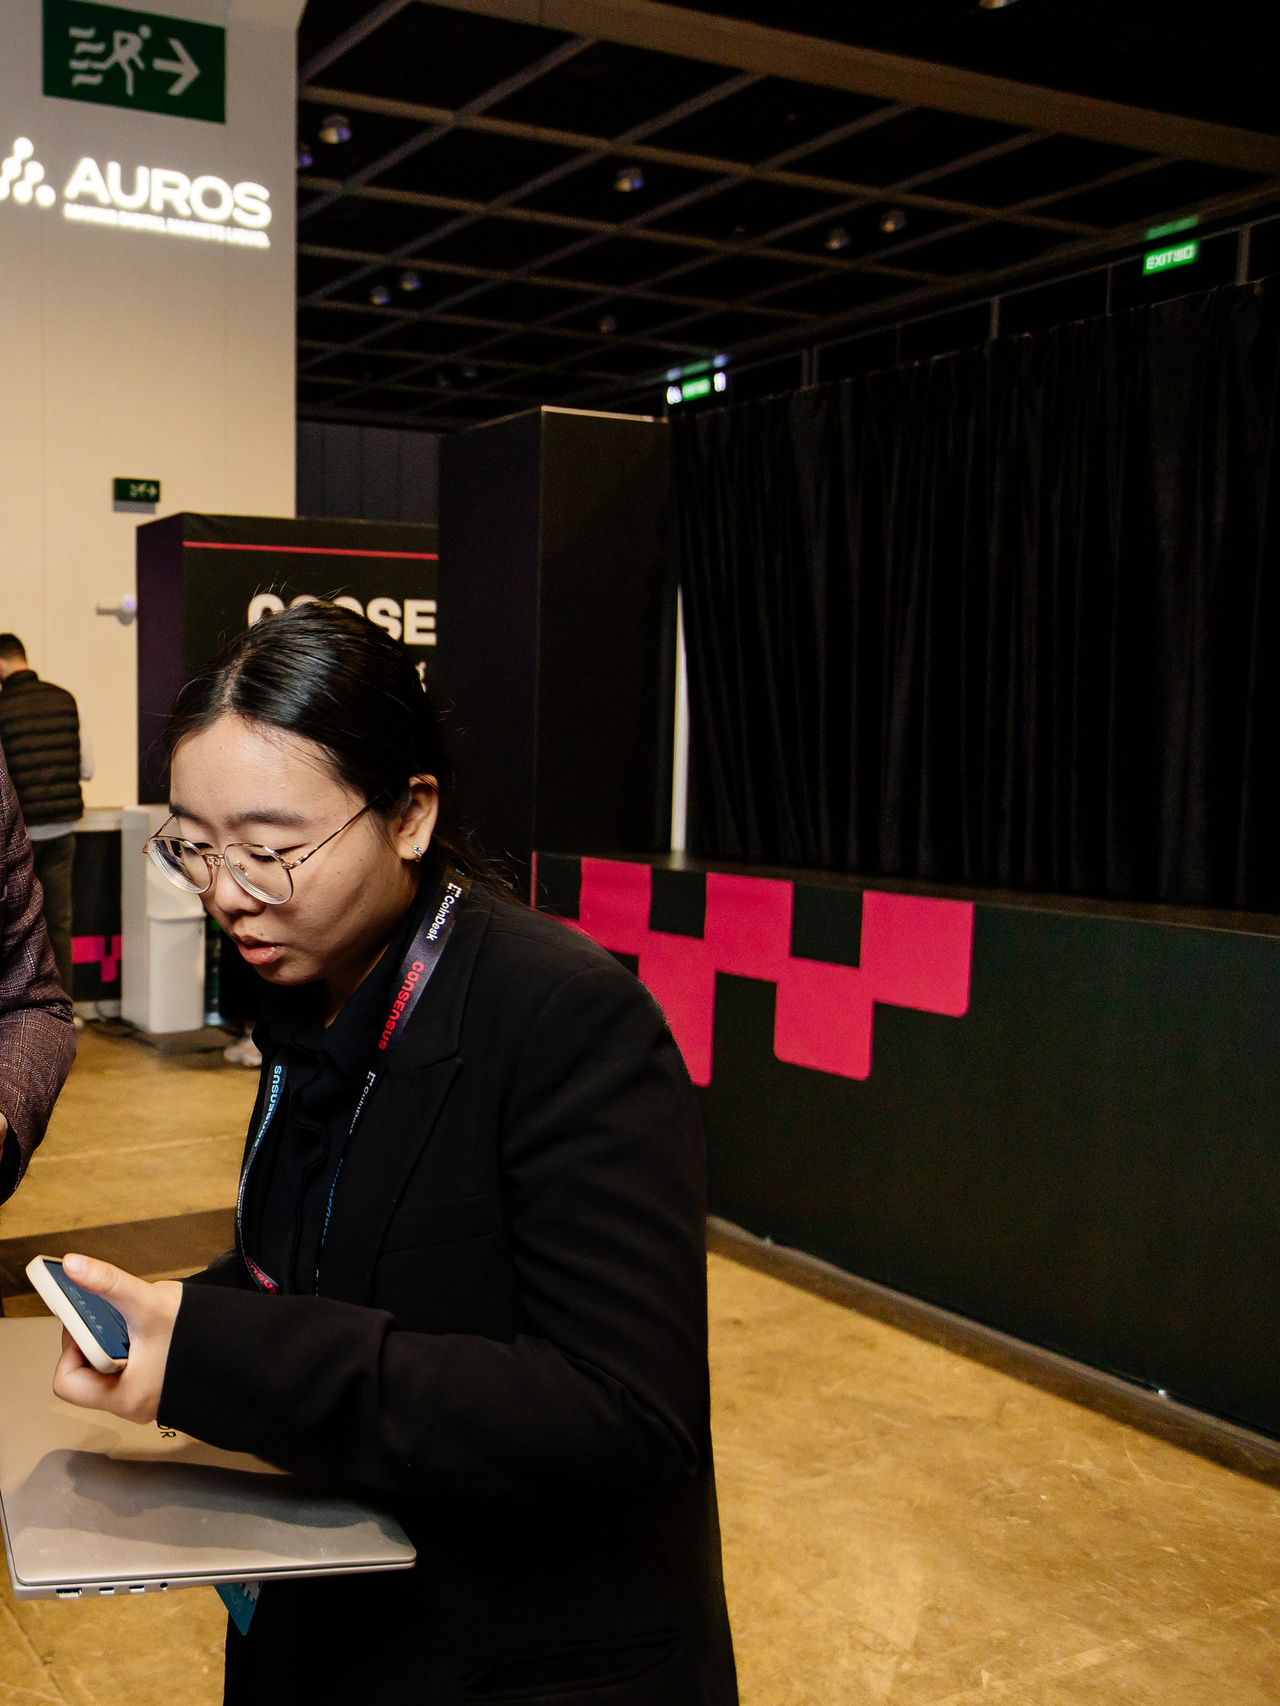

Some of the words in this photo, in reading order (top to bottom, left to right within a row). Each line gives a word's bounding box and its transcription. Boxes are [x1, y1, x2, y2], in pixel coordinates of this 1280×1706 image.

[64, 157, 272, 228] AUROS
[1146, 252, 1174, 270] EXIT
[423, 893, 457, 942] CoinDesk
[378, 961, 425, 1050] CONSENSUS
